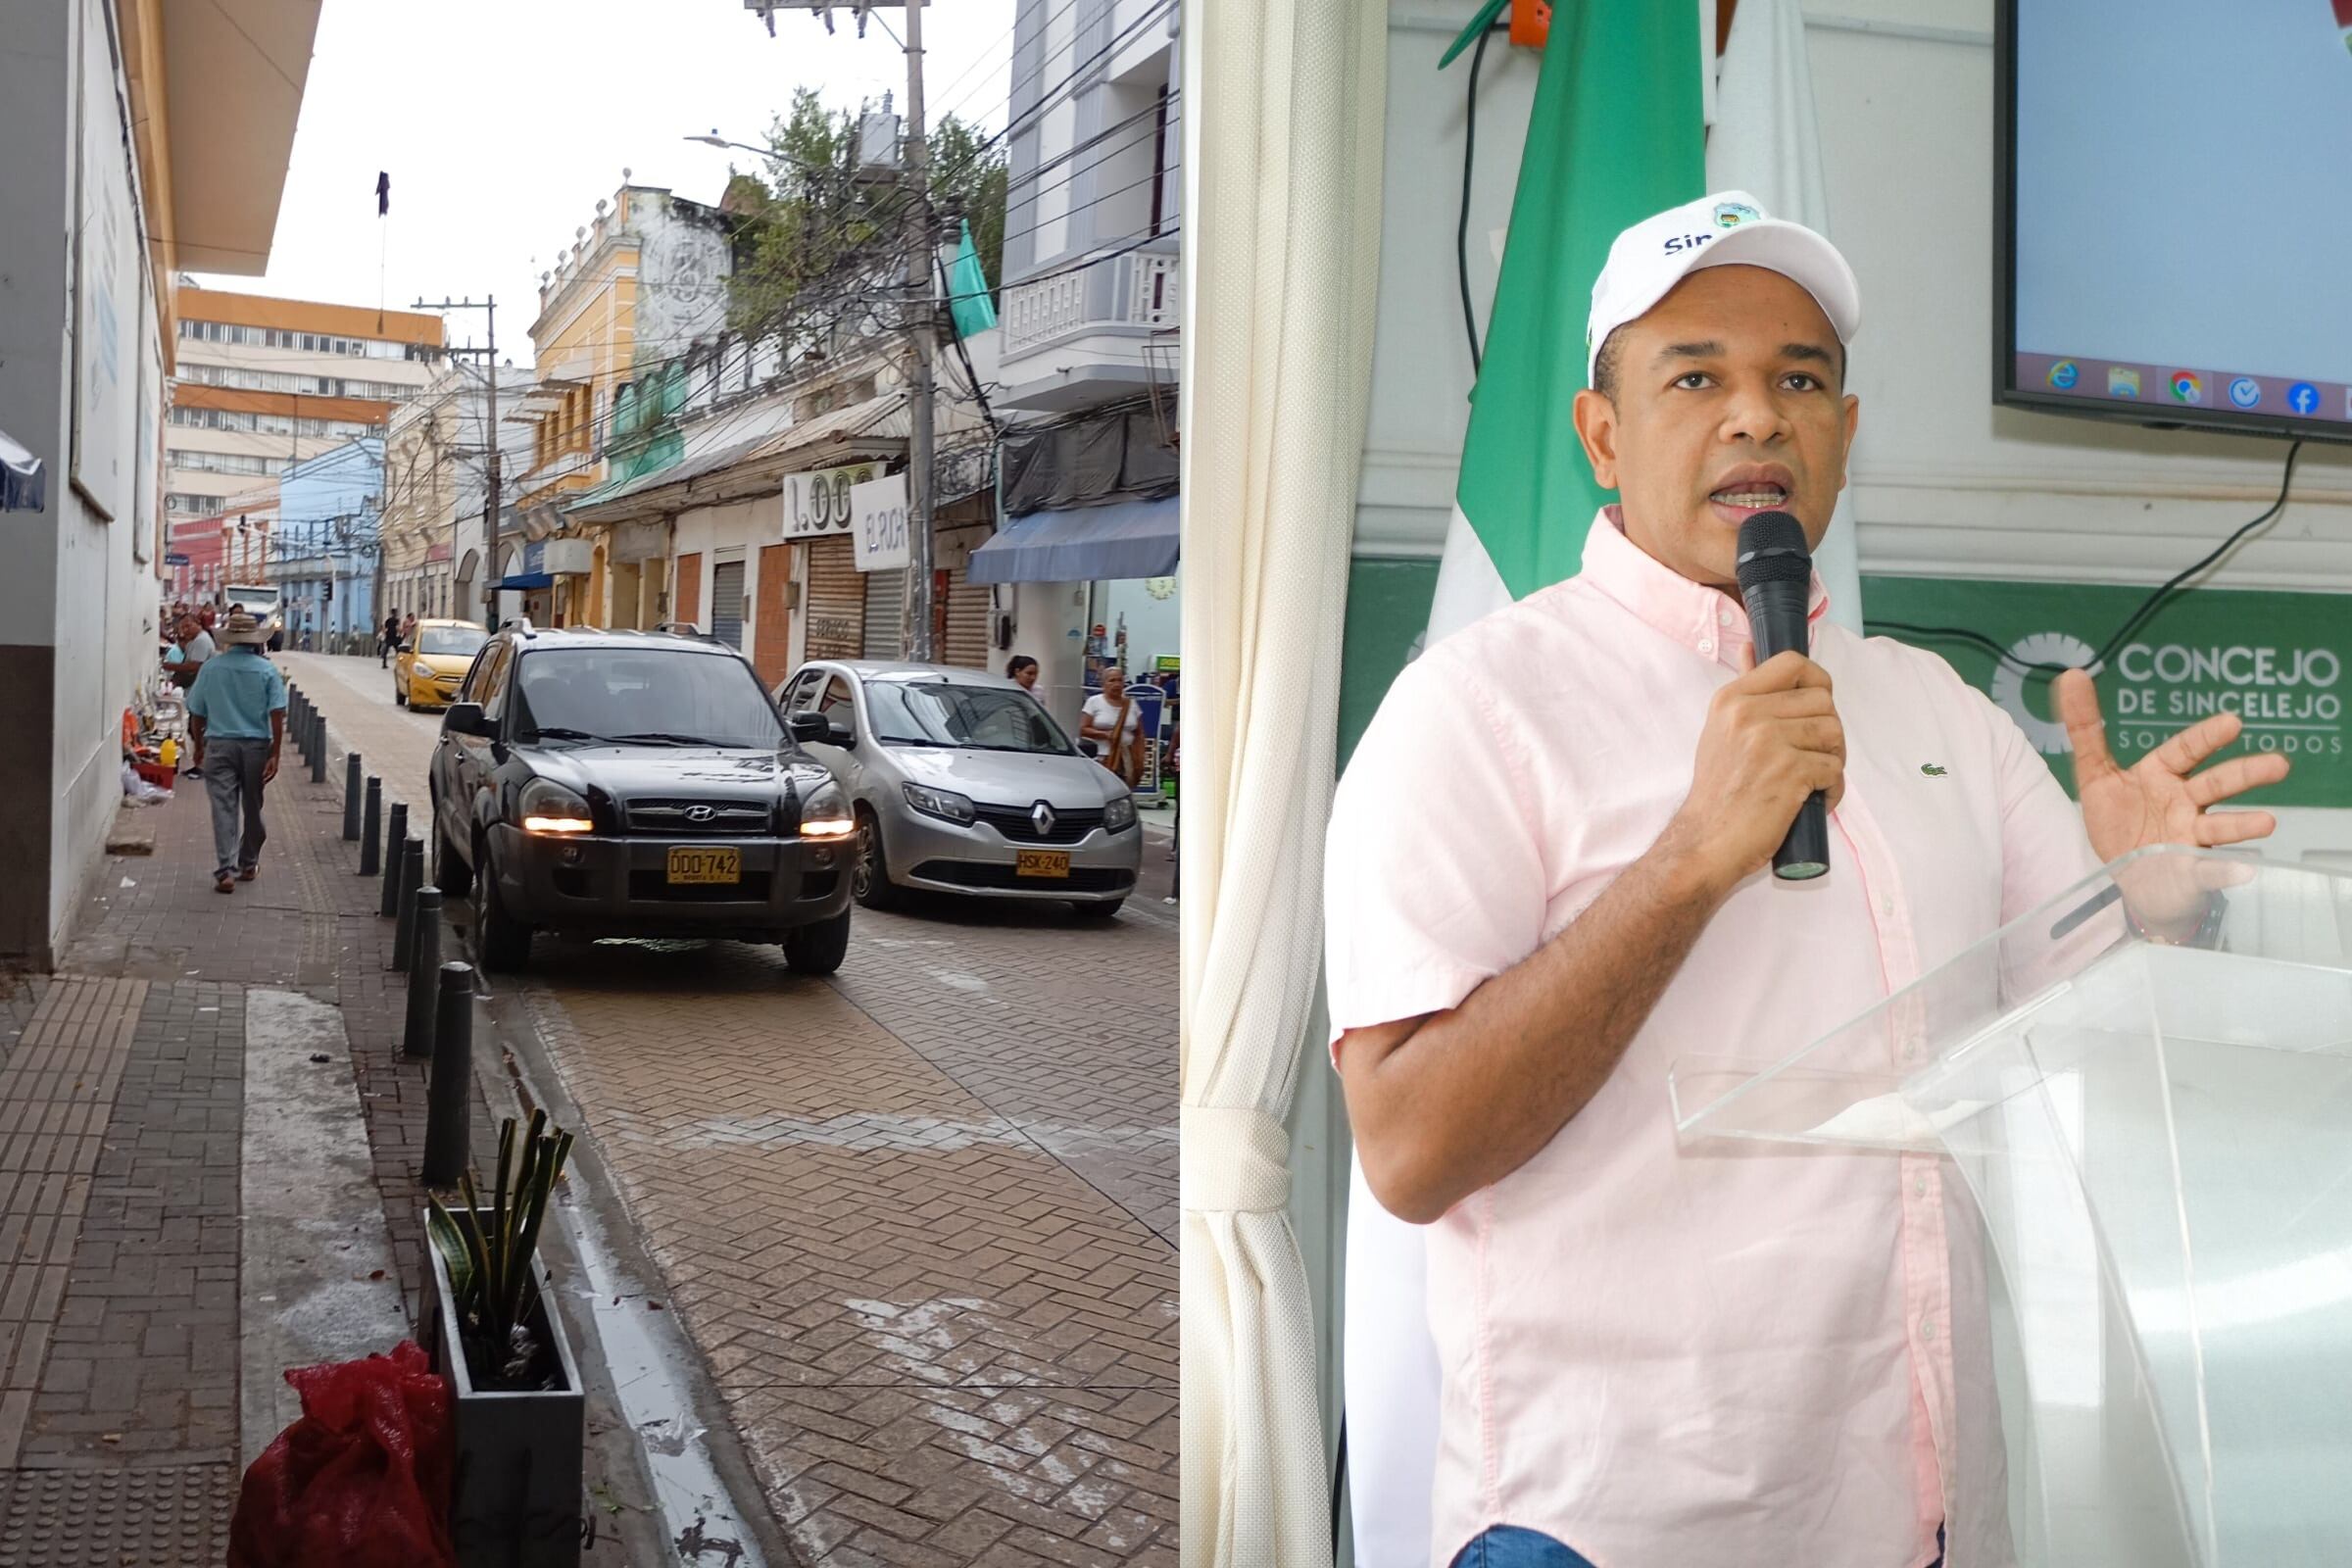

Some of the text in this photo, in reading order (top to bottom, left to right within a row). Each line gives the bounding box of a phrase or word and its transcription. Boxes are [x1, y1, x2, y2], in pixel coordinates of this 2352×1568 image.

[791, 468, 874, 534] 1.00
[2118, 643, 2340, 687] CONCEJO
[2118, 689, 2341, 719] DE SINCELEJO
[2242, 734, 2341, 754] TODOS
